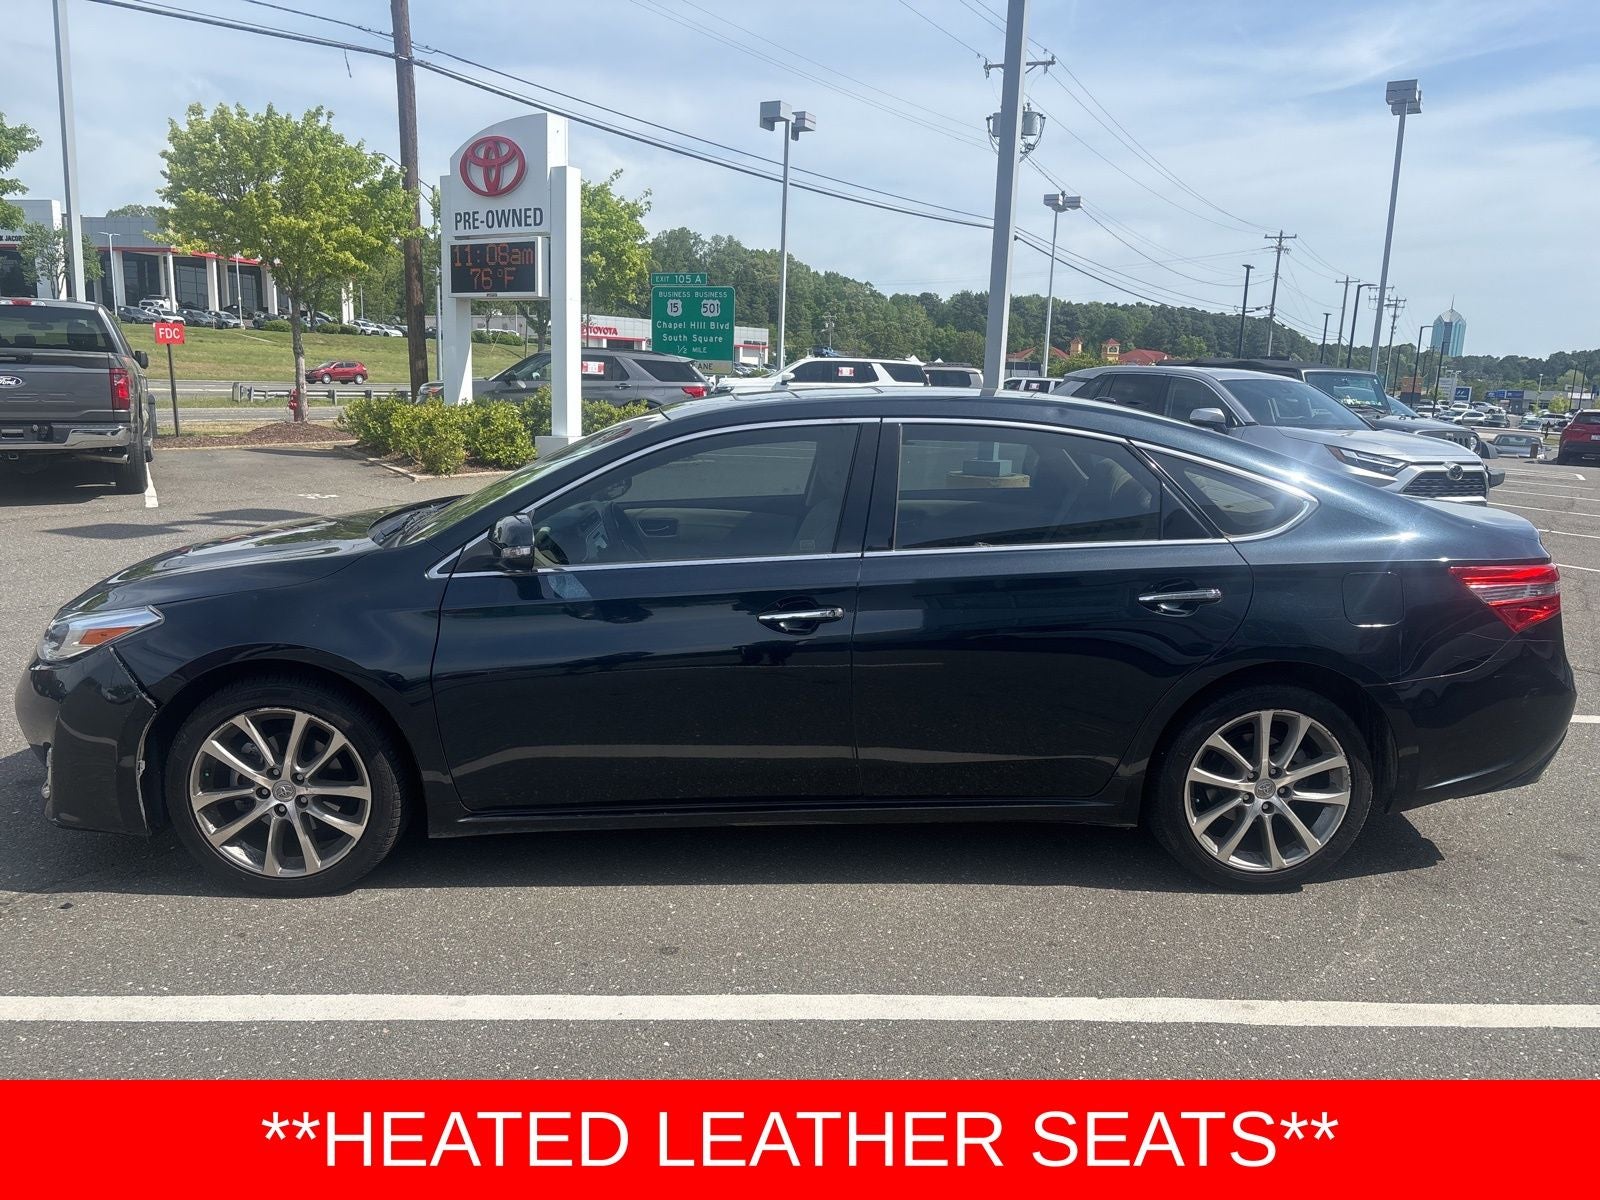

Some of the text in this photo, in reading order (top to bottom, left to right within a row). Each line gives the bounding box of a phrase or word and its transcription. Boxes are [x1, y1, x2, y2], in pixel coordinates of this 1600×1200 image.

[454, 207, 544, 230] PRE-OWNED
[655, 274, 702, 284] EXIT 105 A
[670, 302, 679, 313] 15
[702, 303, 719, 314] 501
[656, 321, 730, 330] Chapel Hill Blvd
[158, 327, 181, 339] FDC
[588, 326, 618, 336] TOYOTA
[662, 333, 723, 343] South Square
[692, 346, 708, 354] MILE
[696, 362, 713, 371] ANE
